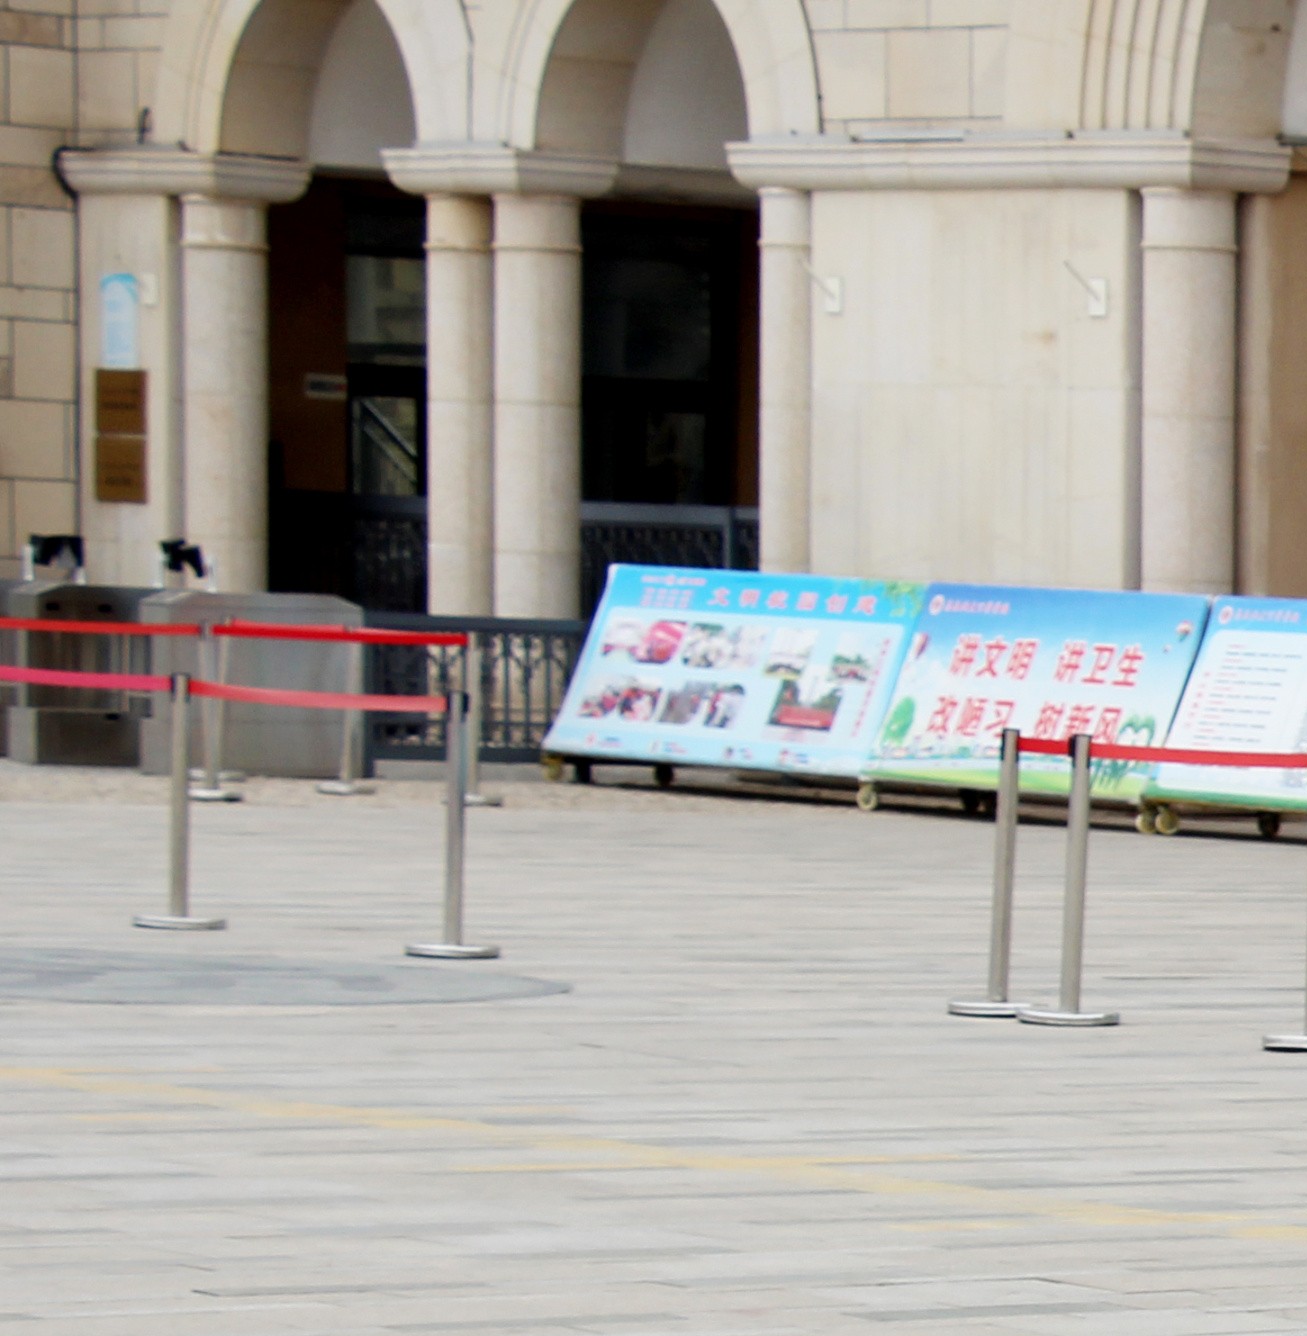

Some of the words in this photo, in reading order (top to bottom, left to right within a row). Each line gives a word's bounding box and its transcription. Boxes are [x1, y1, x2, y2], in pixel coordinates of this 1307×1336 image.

[950, 633, 1040, 681] 讲文明
[1054, 640, 1144, 687] 讲卫生
[926, 695, 1016, 738] 改陋习
[1033, 700, 1122, 745] 树新风
